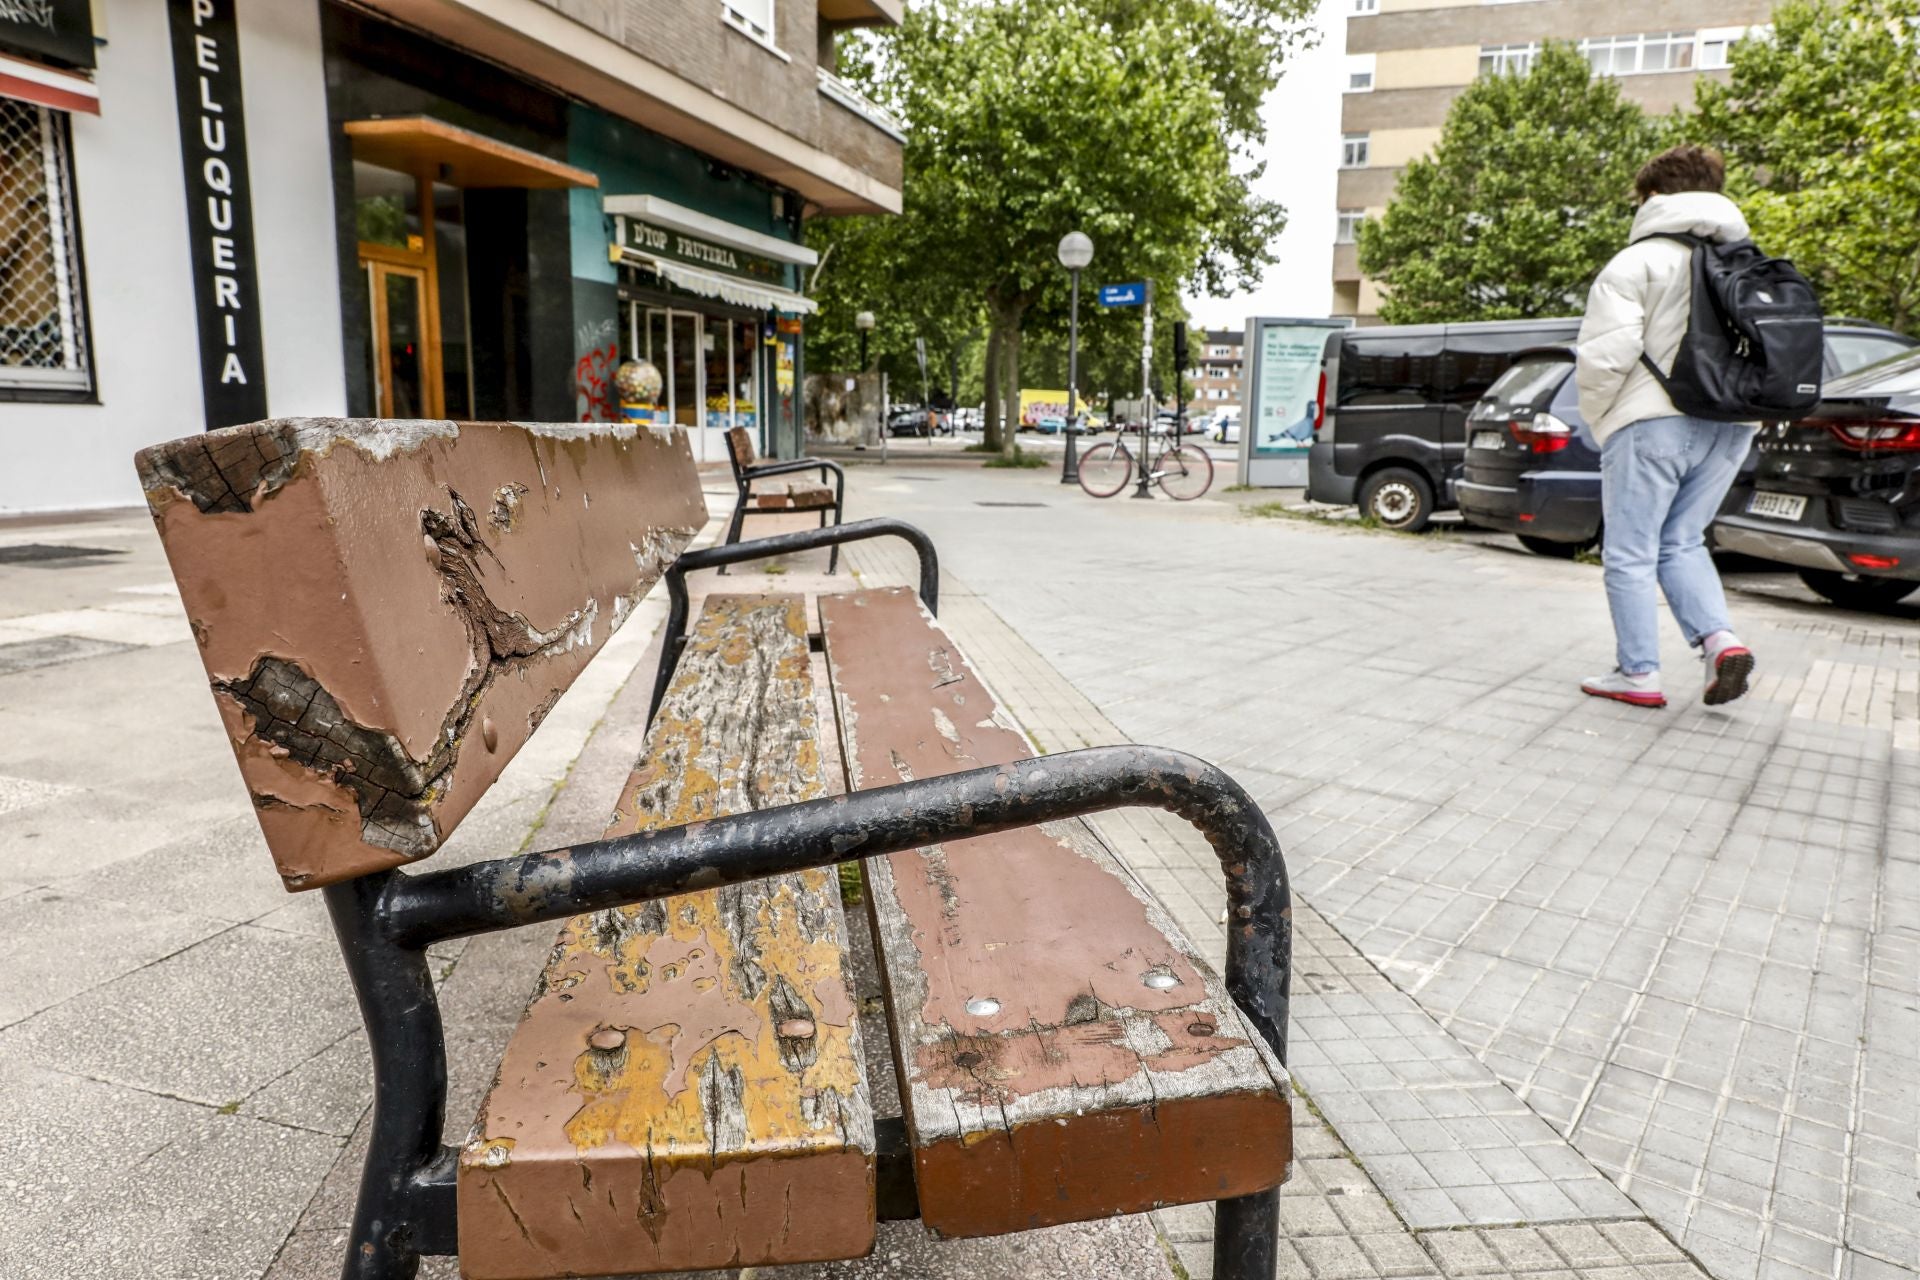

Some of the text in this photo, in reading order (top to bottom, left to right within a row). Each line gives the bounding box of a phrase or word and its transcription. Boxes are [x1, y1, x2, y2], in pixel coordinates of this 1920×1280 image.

[192, 0, 247, 385] PELUQUERIA
[633, 223, 738, 269] D'TOP FRUTERIA
